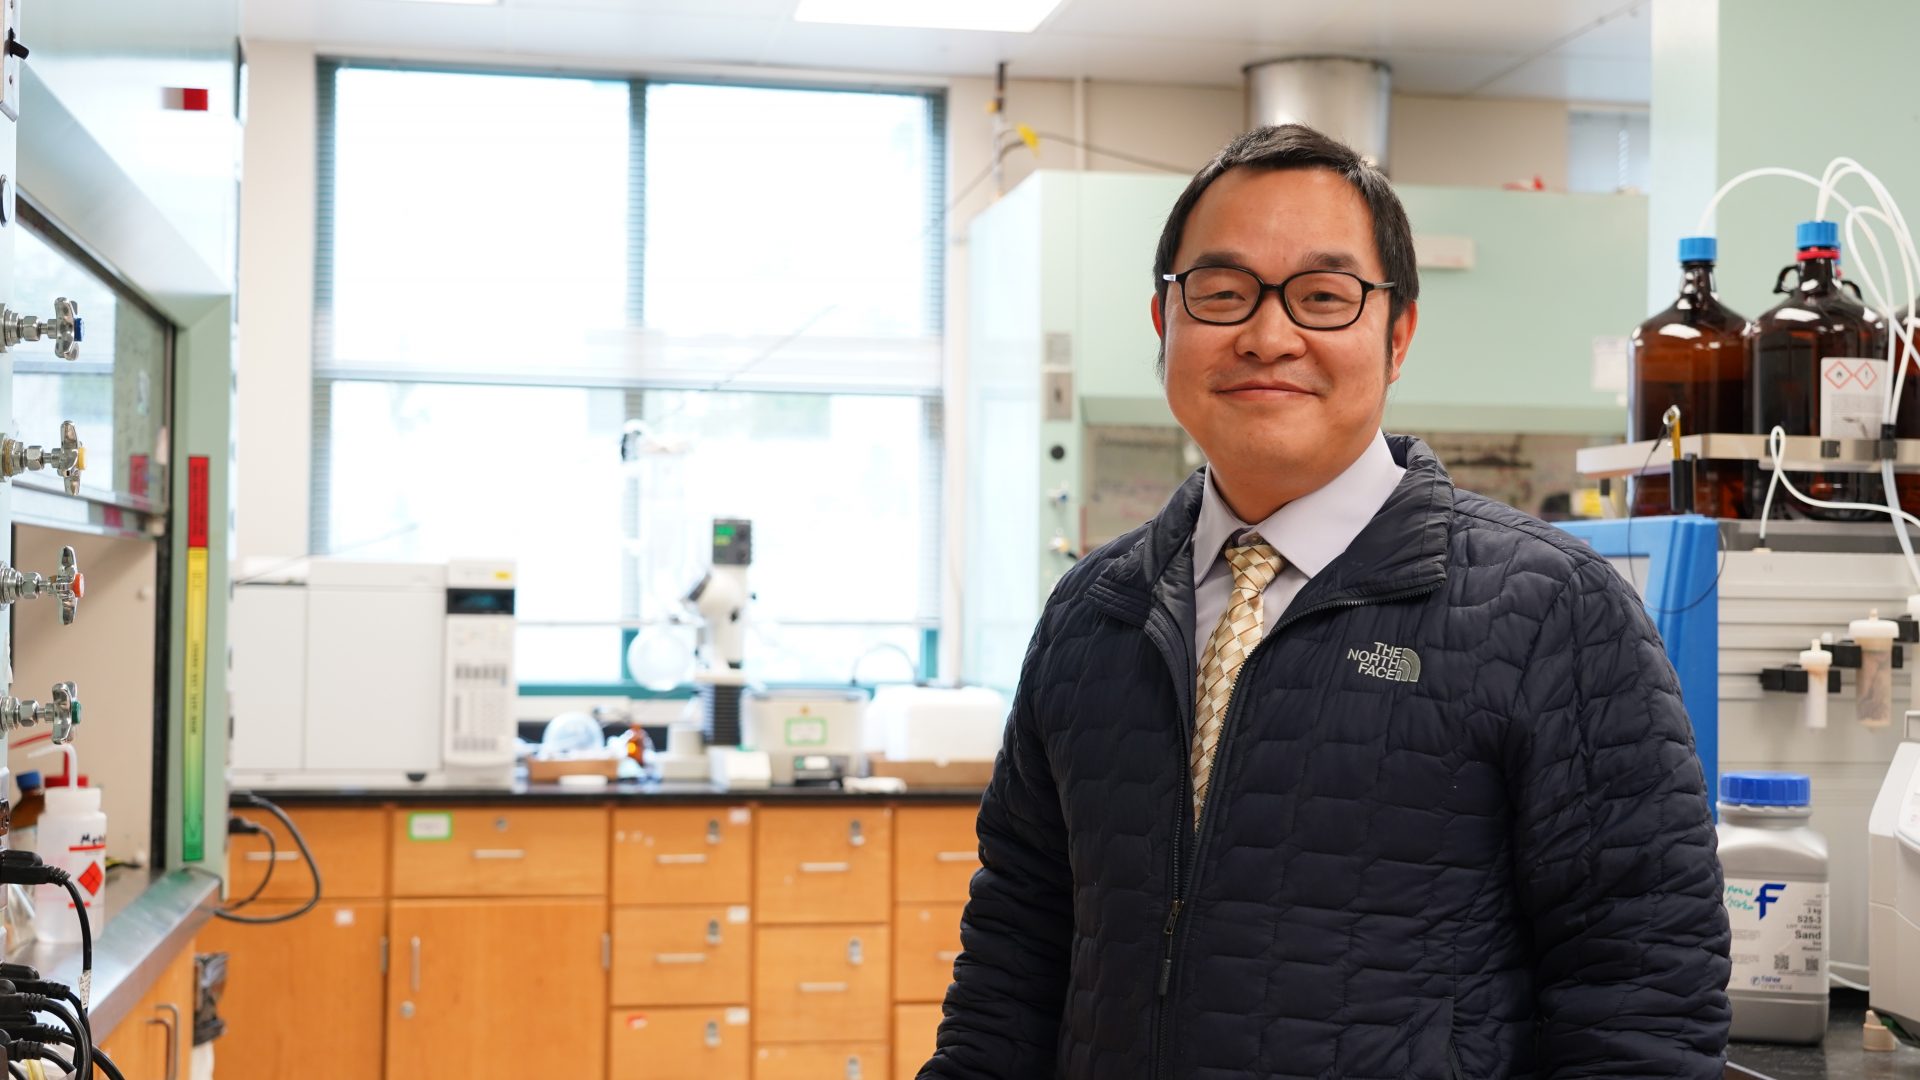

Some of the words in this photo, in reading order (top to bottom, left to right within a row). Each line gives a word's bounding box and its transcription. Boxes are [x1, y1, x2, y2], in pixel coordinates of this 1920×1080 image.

[1347, 648, 1400, 670] NORTH
[1374, 641, 1403, 659] THE
[1358, 661, 1397, 680] FACE
[1795, 929, 1822, 940] Sand
